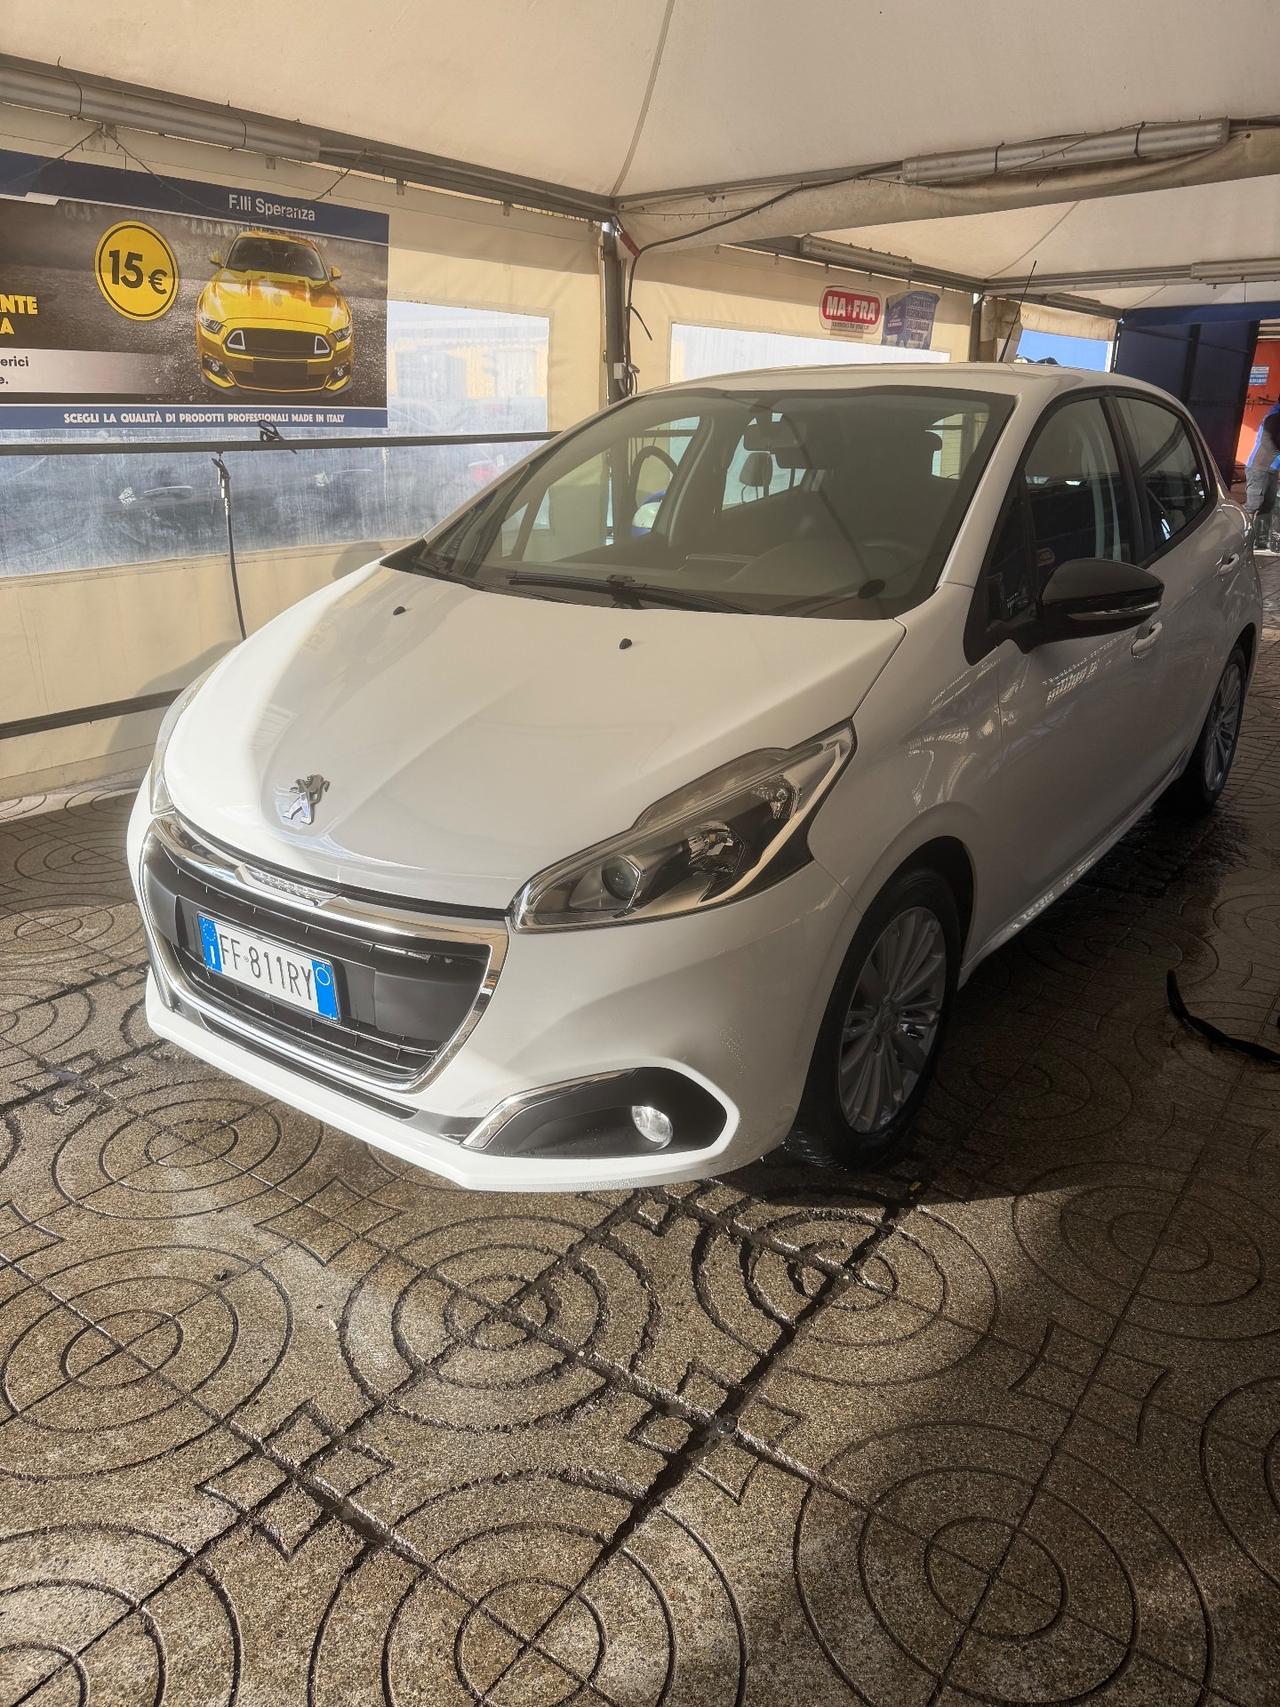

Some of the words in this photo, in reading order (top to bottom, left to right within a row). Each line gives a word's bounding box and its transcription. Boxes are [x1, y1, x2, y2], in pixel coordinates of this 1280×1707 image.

[255, 198, 316, 222] Speranza
[64, 412, 99, 424] SCEGLI
[103, 413, 117, 424] LA
[120, 411, 162, 424] QUALITÀ
[166, 413, 176, 423] DI
[179, 413, 225, 423] PRODOTTI
[228, 413, 289, 423] PROFESSIONALI
[291, 413, 314, 423] MADE
[315, 414, 324, 423] IN
[326, 414, 345, 423] ITALY
